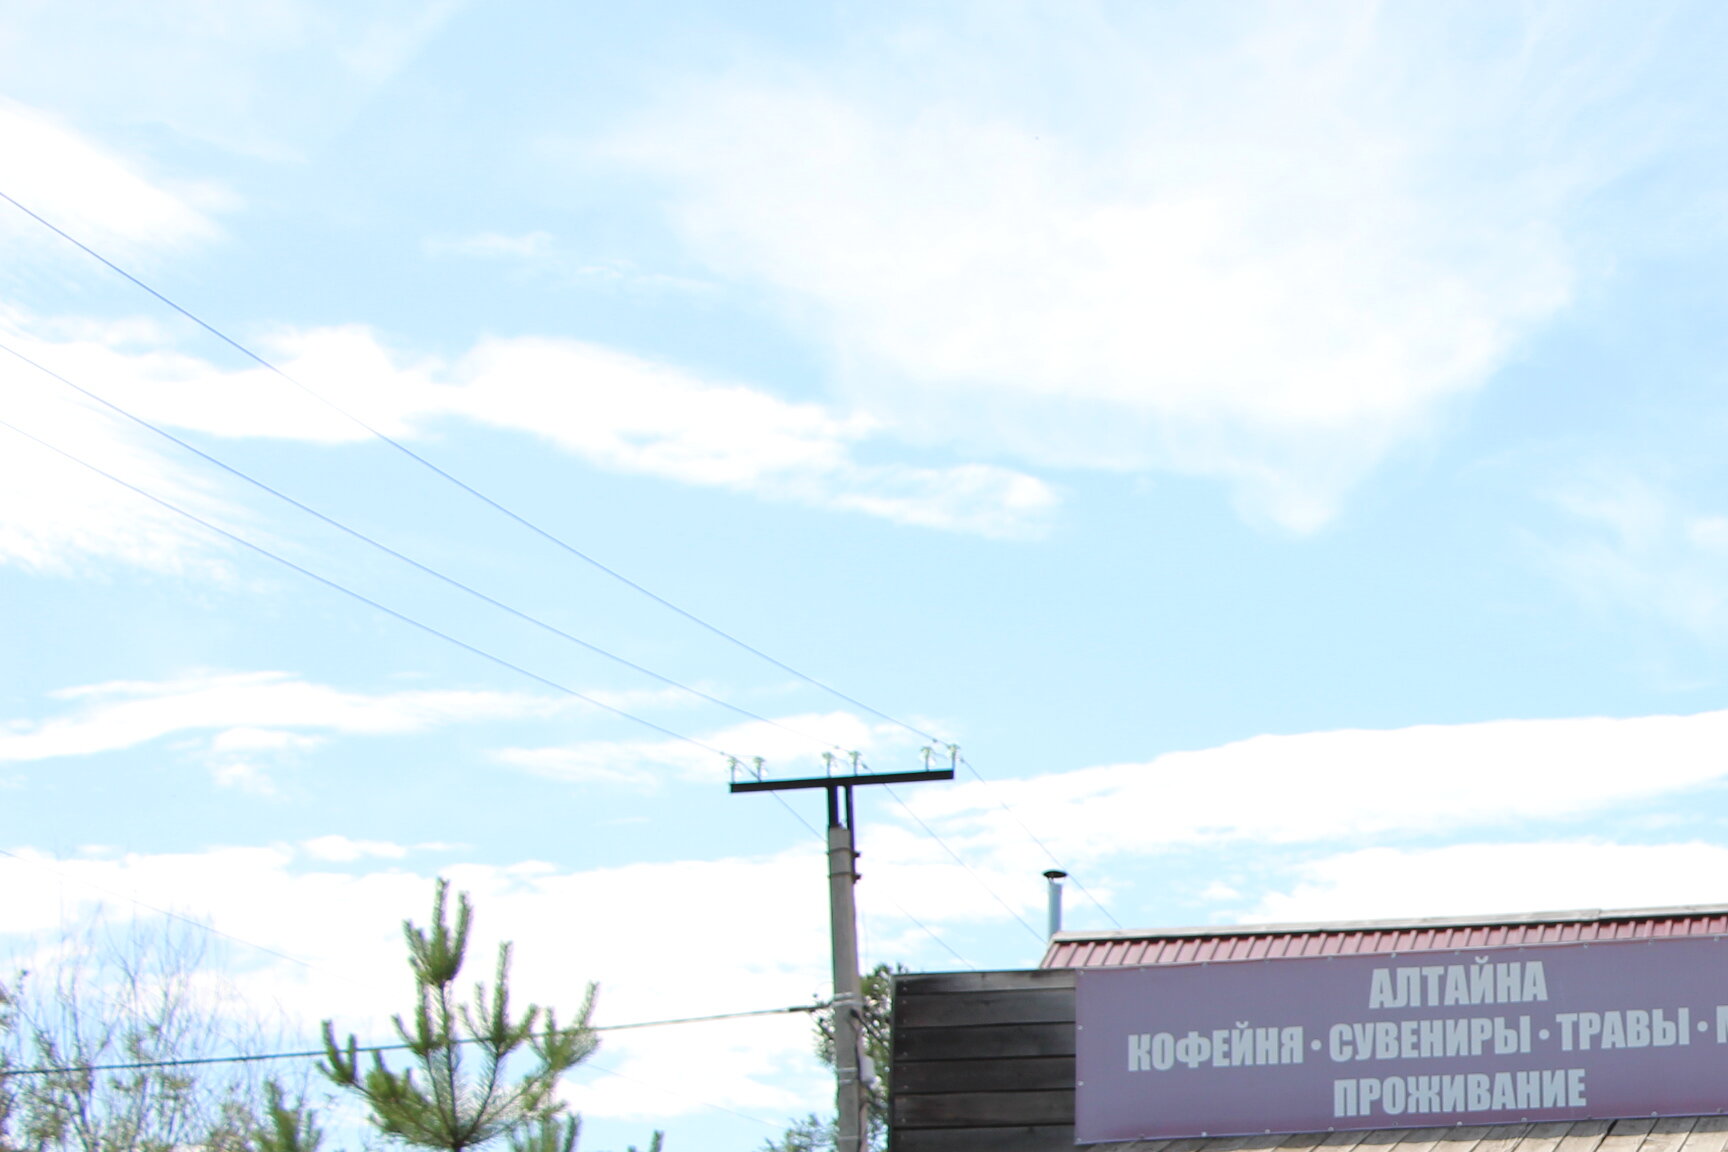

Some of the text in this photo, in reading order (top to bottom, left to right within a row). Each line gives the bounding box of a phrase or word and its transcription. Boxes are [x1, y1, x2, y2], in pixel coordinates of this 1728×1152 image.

[1369, 956, 1548, 1009] АЛТАЙНА
[1128, 1021, 1303, 1071] КОФЕЙНЯ
[1330, 1016, 1531, 1062] СУВЕНИРЫ
[1556, 1008, 1689, 1051] ТРАВЫ
[1334, 1069, 1586, 1117] ПРОЖИВАНИЕ
